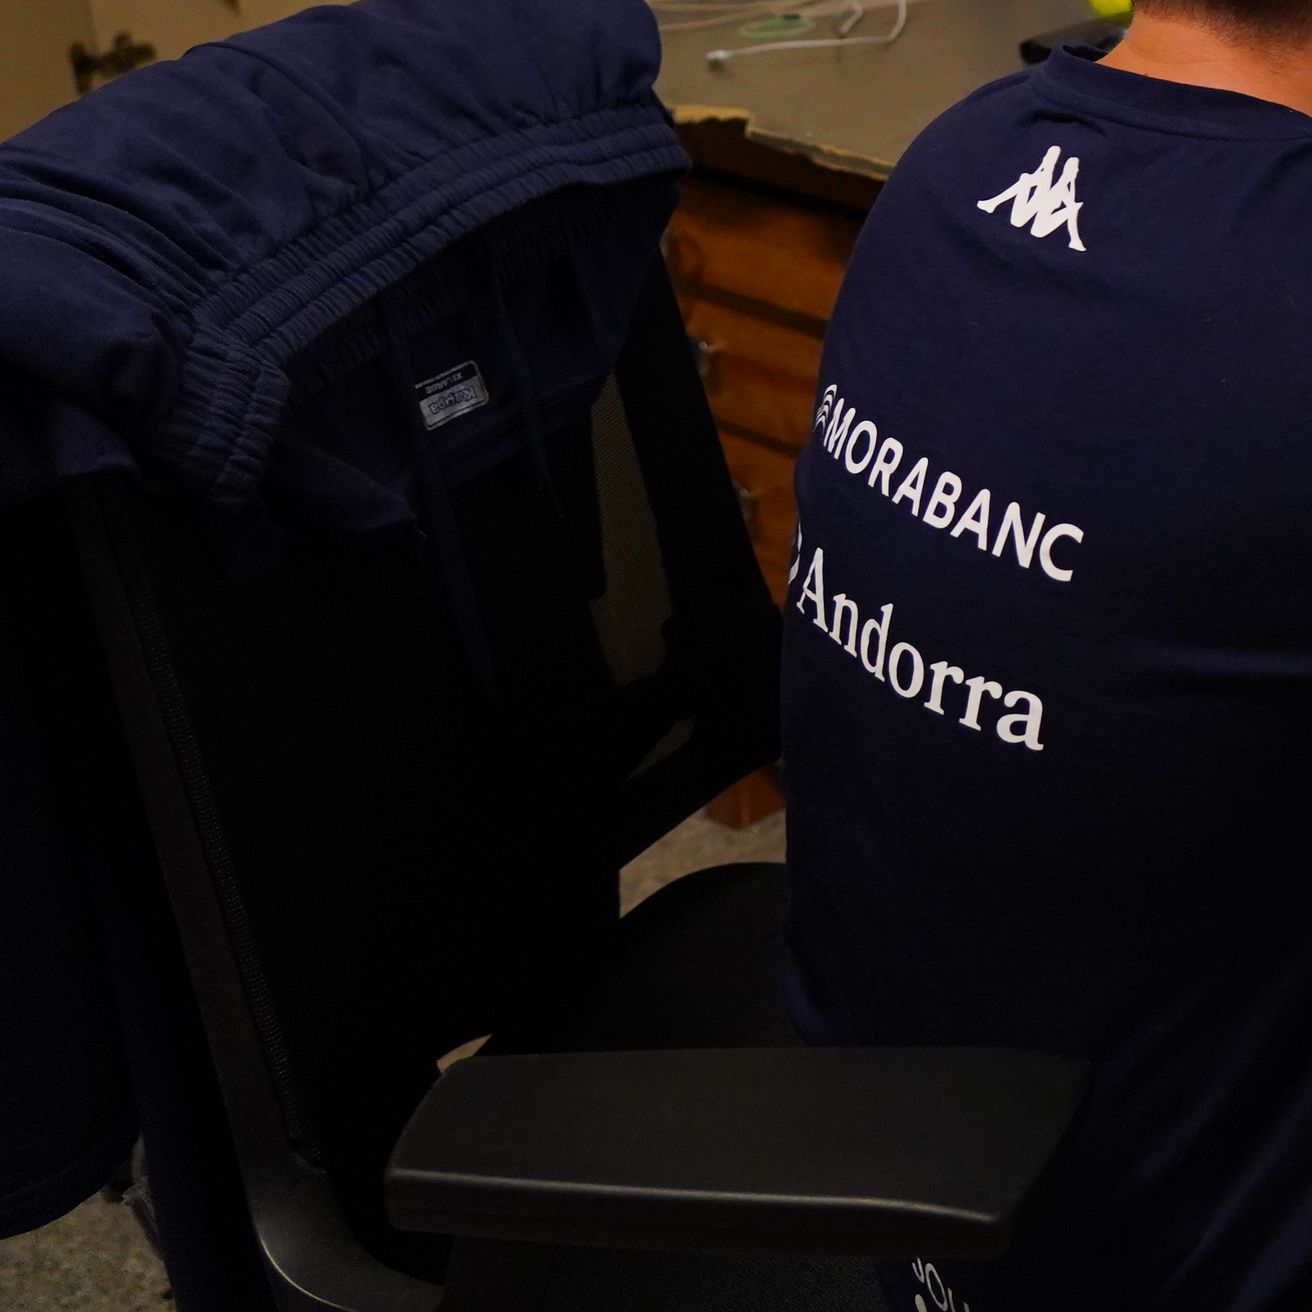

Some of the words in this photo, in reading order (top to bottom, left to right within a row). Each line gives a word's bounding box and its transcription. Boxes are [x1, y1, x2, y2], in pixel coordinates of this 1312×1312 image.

[428, 385, 477, 415] Kappa
[823, 398, 1084, 582] MORABANC
[796, 547, 1044, 751] Andorra
